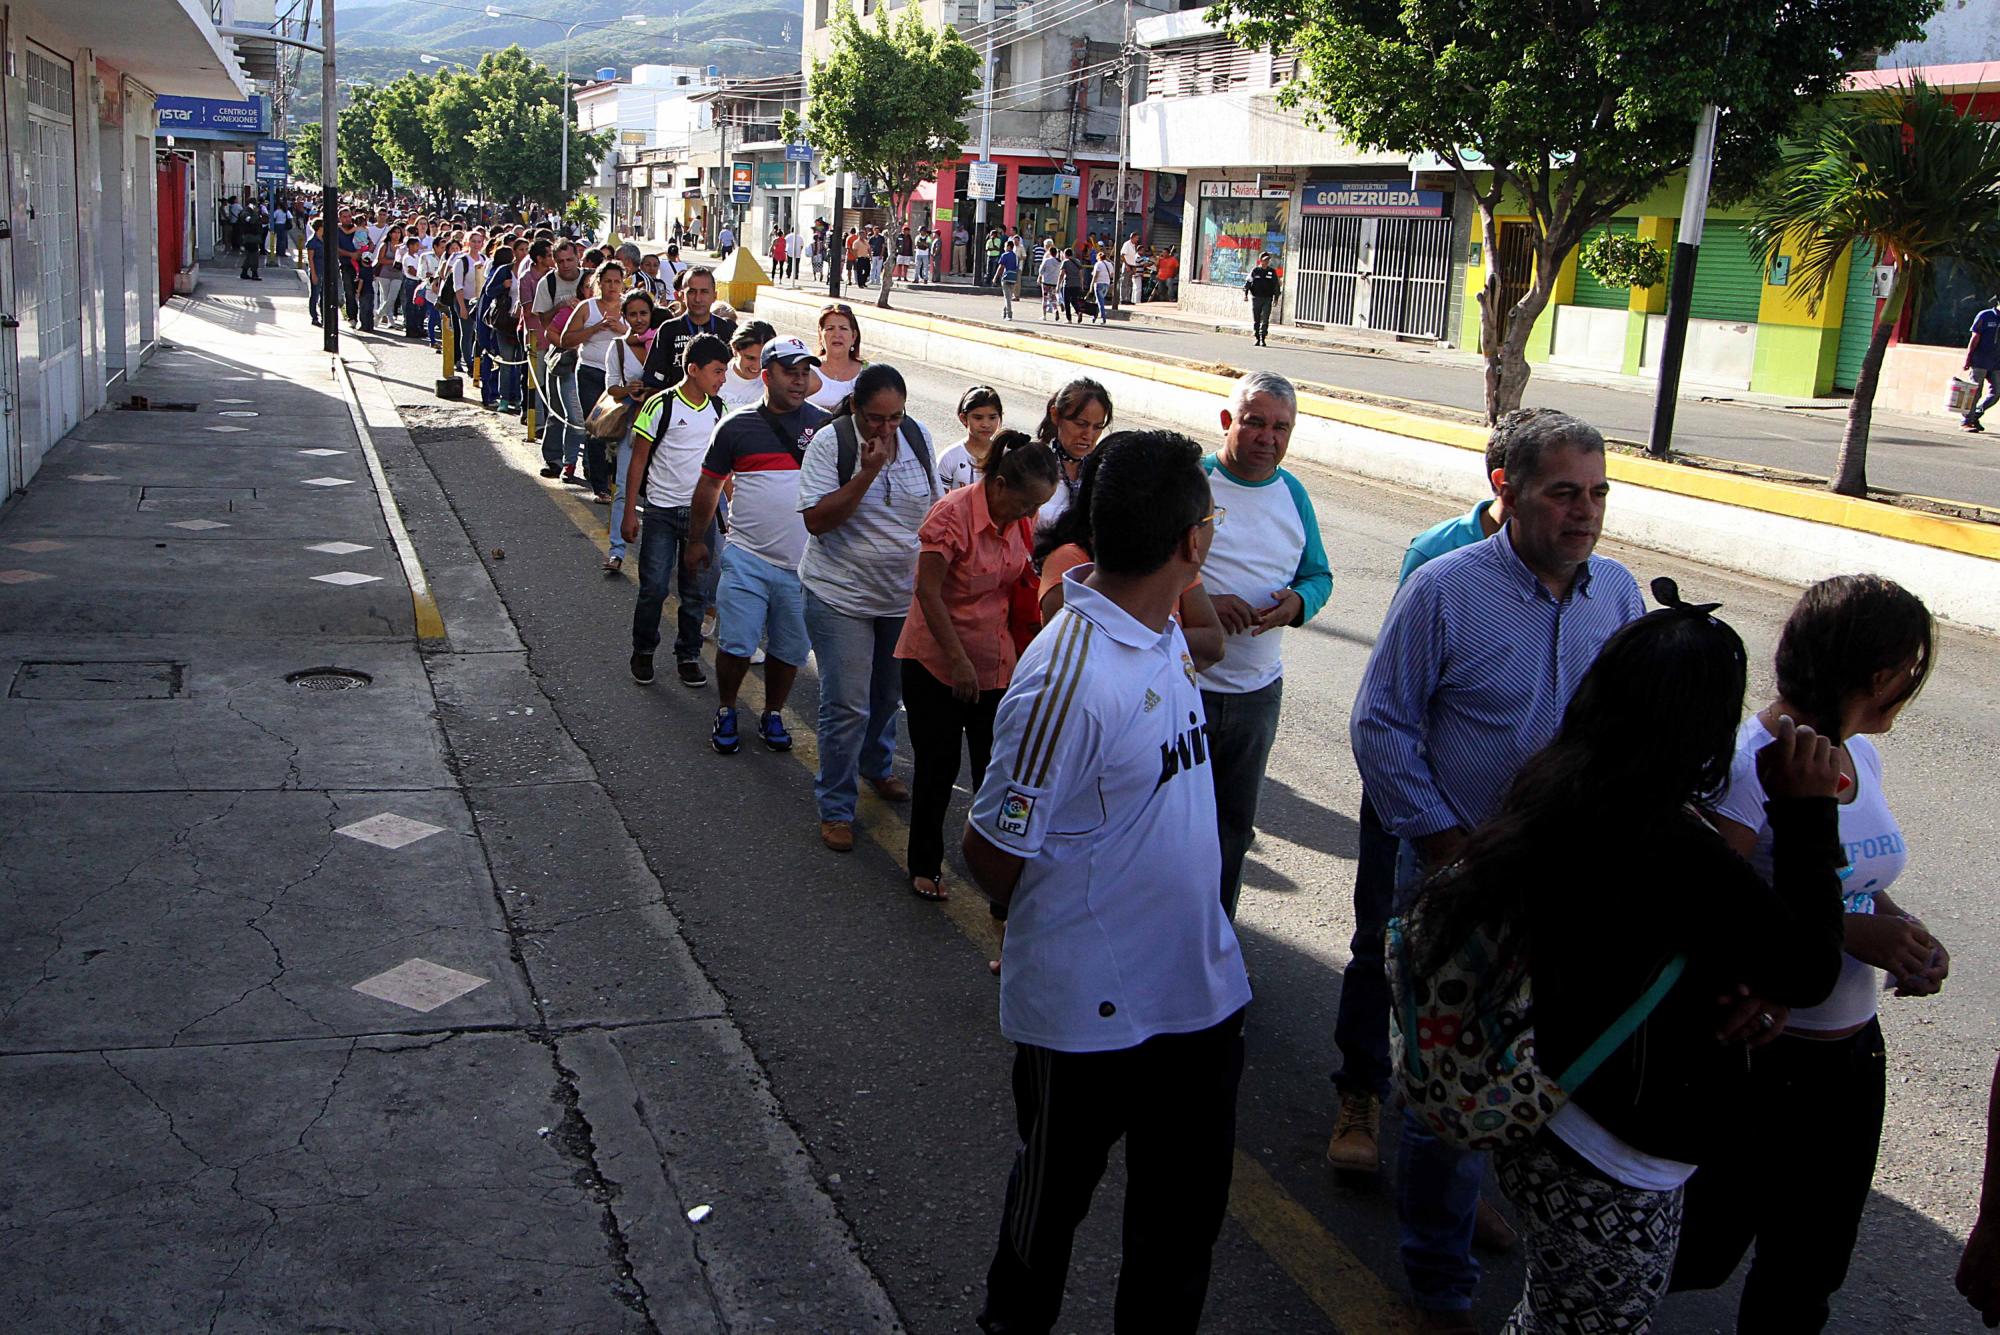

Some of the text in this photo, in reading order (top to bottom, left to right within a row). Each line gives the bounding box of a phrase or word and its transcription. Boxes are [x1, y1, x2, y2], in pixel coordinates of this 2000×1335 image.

[219, 107, 247, 116] CENTRO
[212, 115, 258, 124] CONEXIONES
[1317, 191, 1420, 206] GOMEZRUEDA
[1002, 820, 1021, 832] LFP
